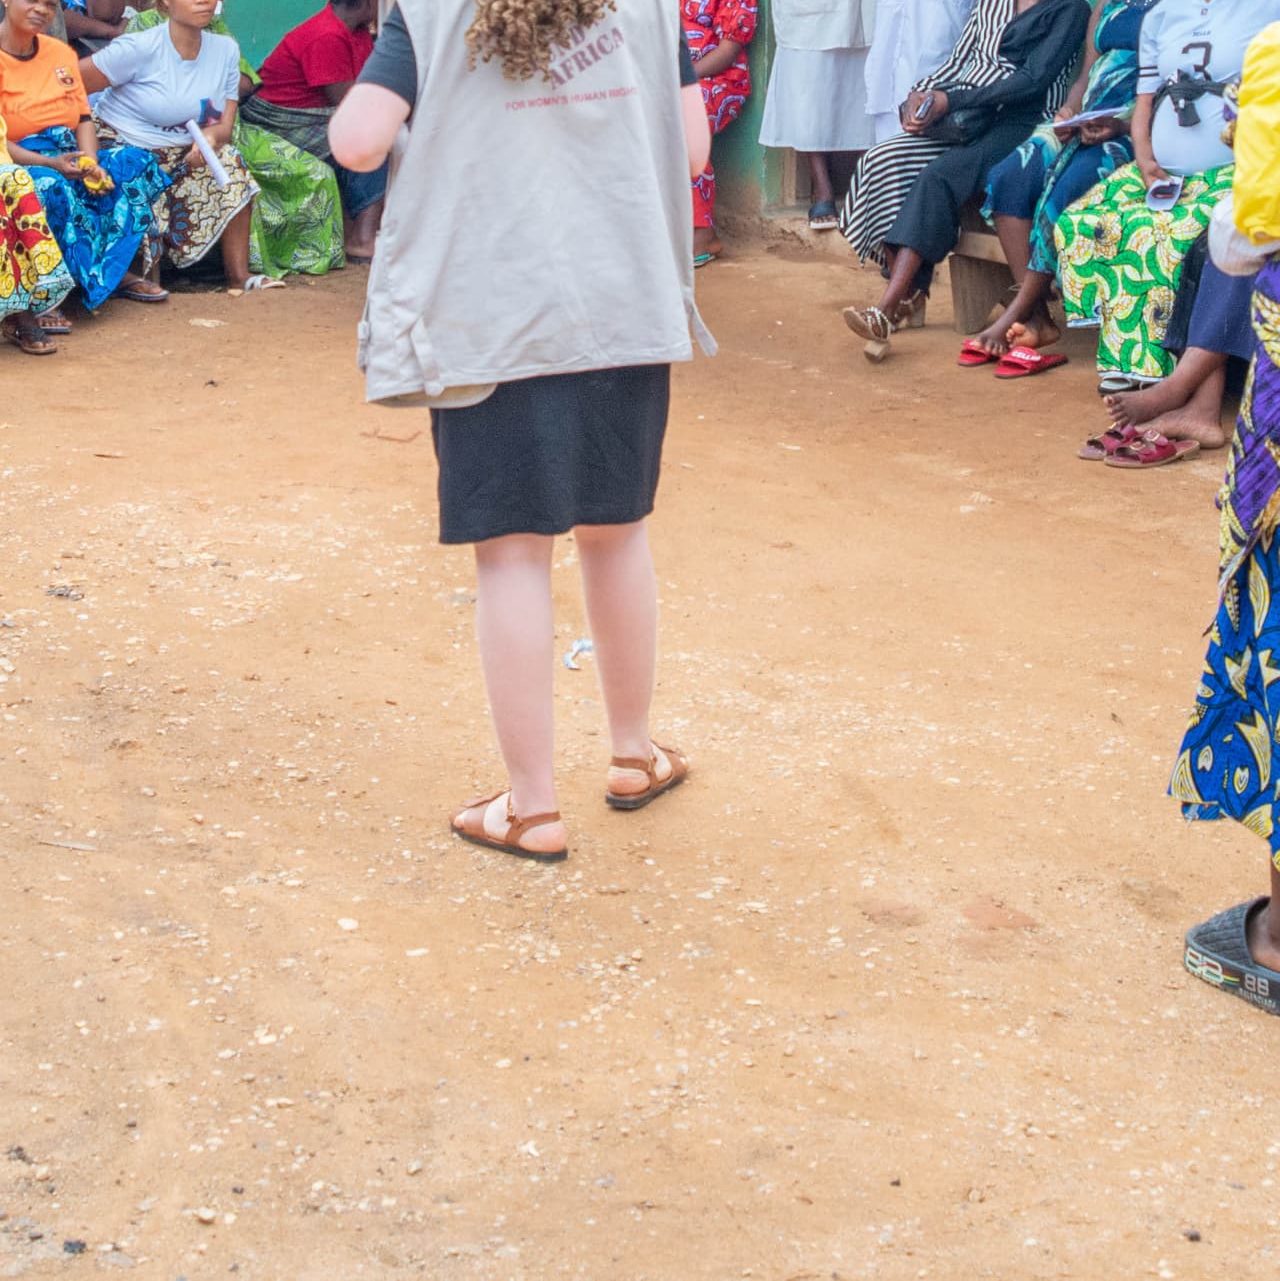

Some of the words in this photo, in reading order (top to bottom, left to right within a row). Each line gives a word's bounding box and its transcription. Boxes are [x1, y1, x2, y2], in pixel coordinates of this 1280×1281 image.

[549, 27, 625, 90] AFRICA
[504, 100, 526, 111] FOR
[571, 91, 607, 102] HUMAN
